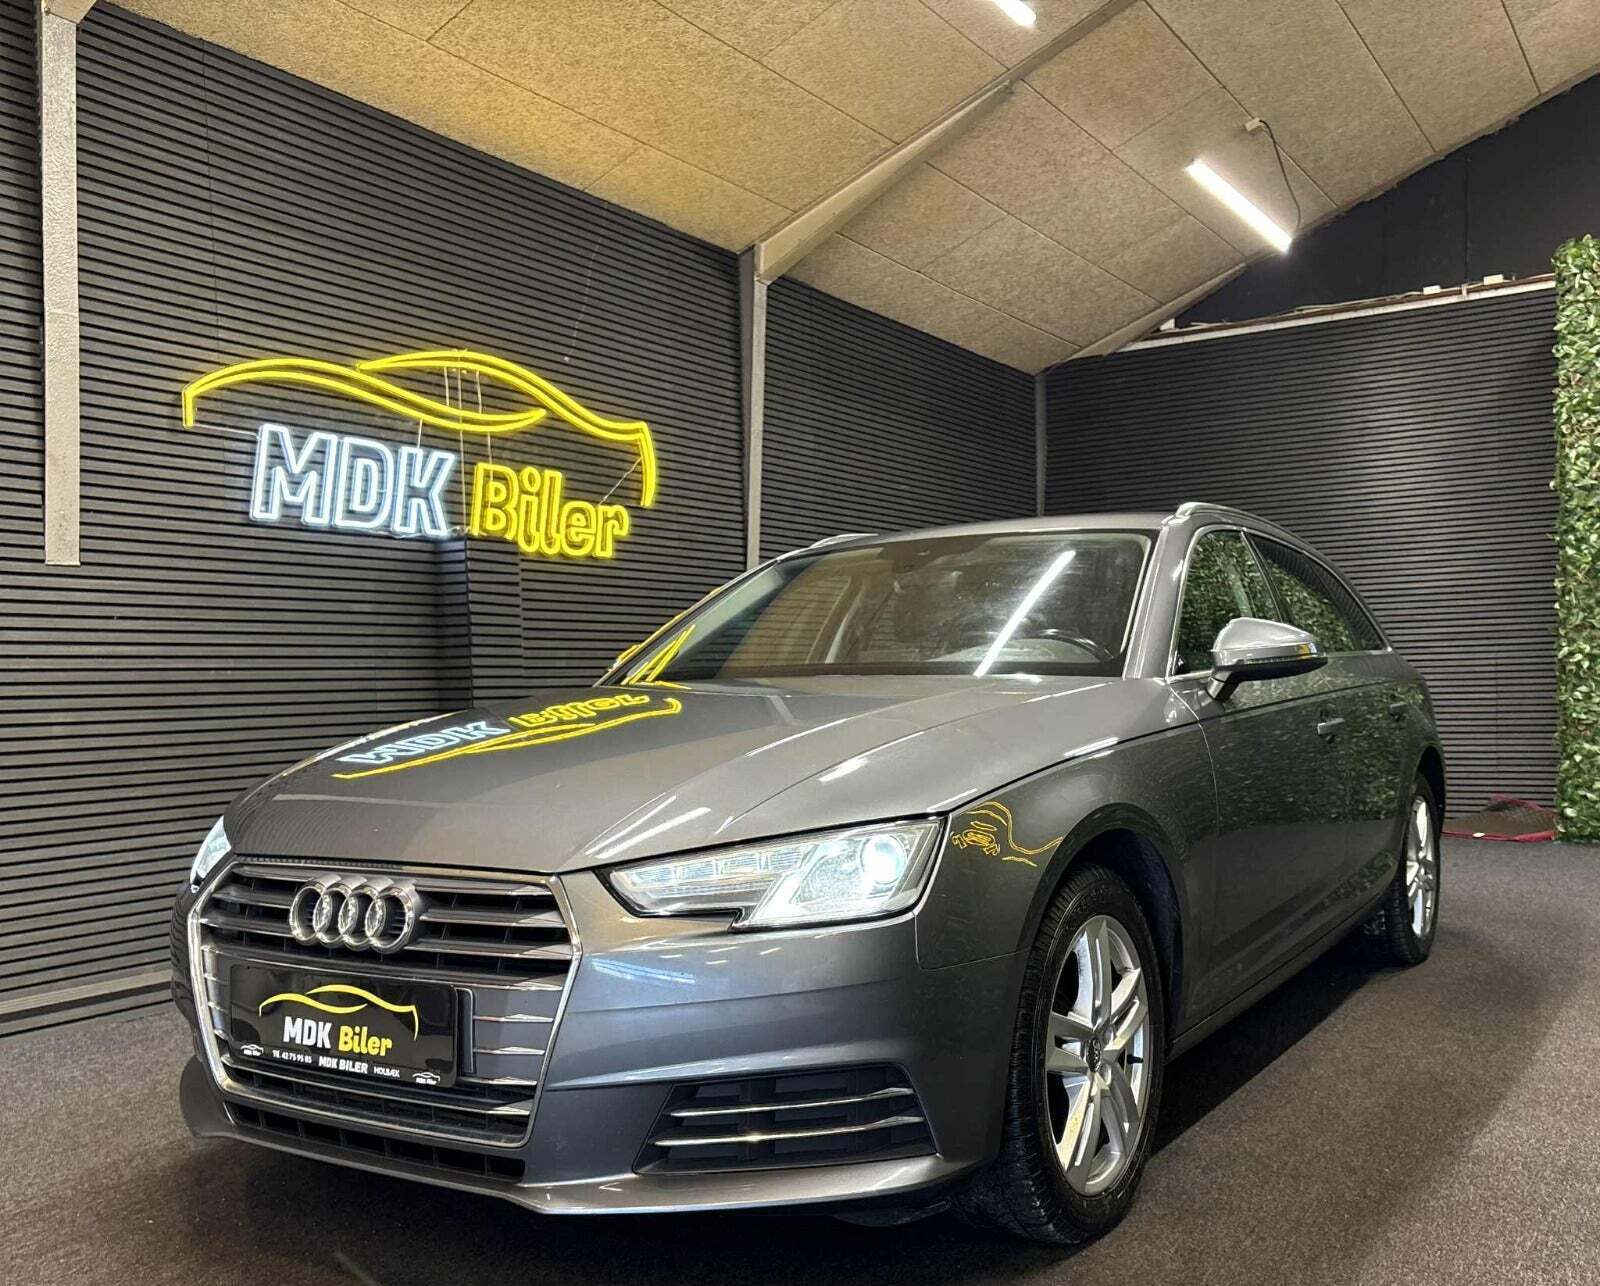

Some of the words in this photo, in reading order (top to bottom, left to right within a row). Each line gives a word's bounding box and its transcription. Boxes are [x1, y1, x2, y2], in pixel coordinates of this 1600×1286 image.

[251, 423, 455, 536] MDK
[470, 462, 631, 559] Biler
[283, 1016, 332, 1048] MDK
[338, 1025, 393, 1056] Biler
[318, 1055, 338, 1069] MDK
[338, 1058, 369, 1074] BILER
